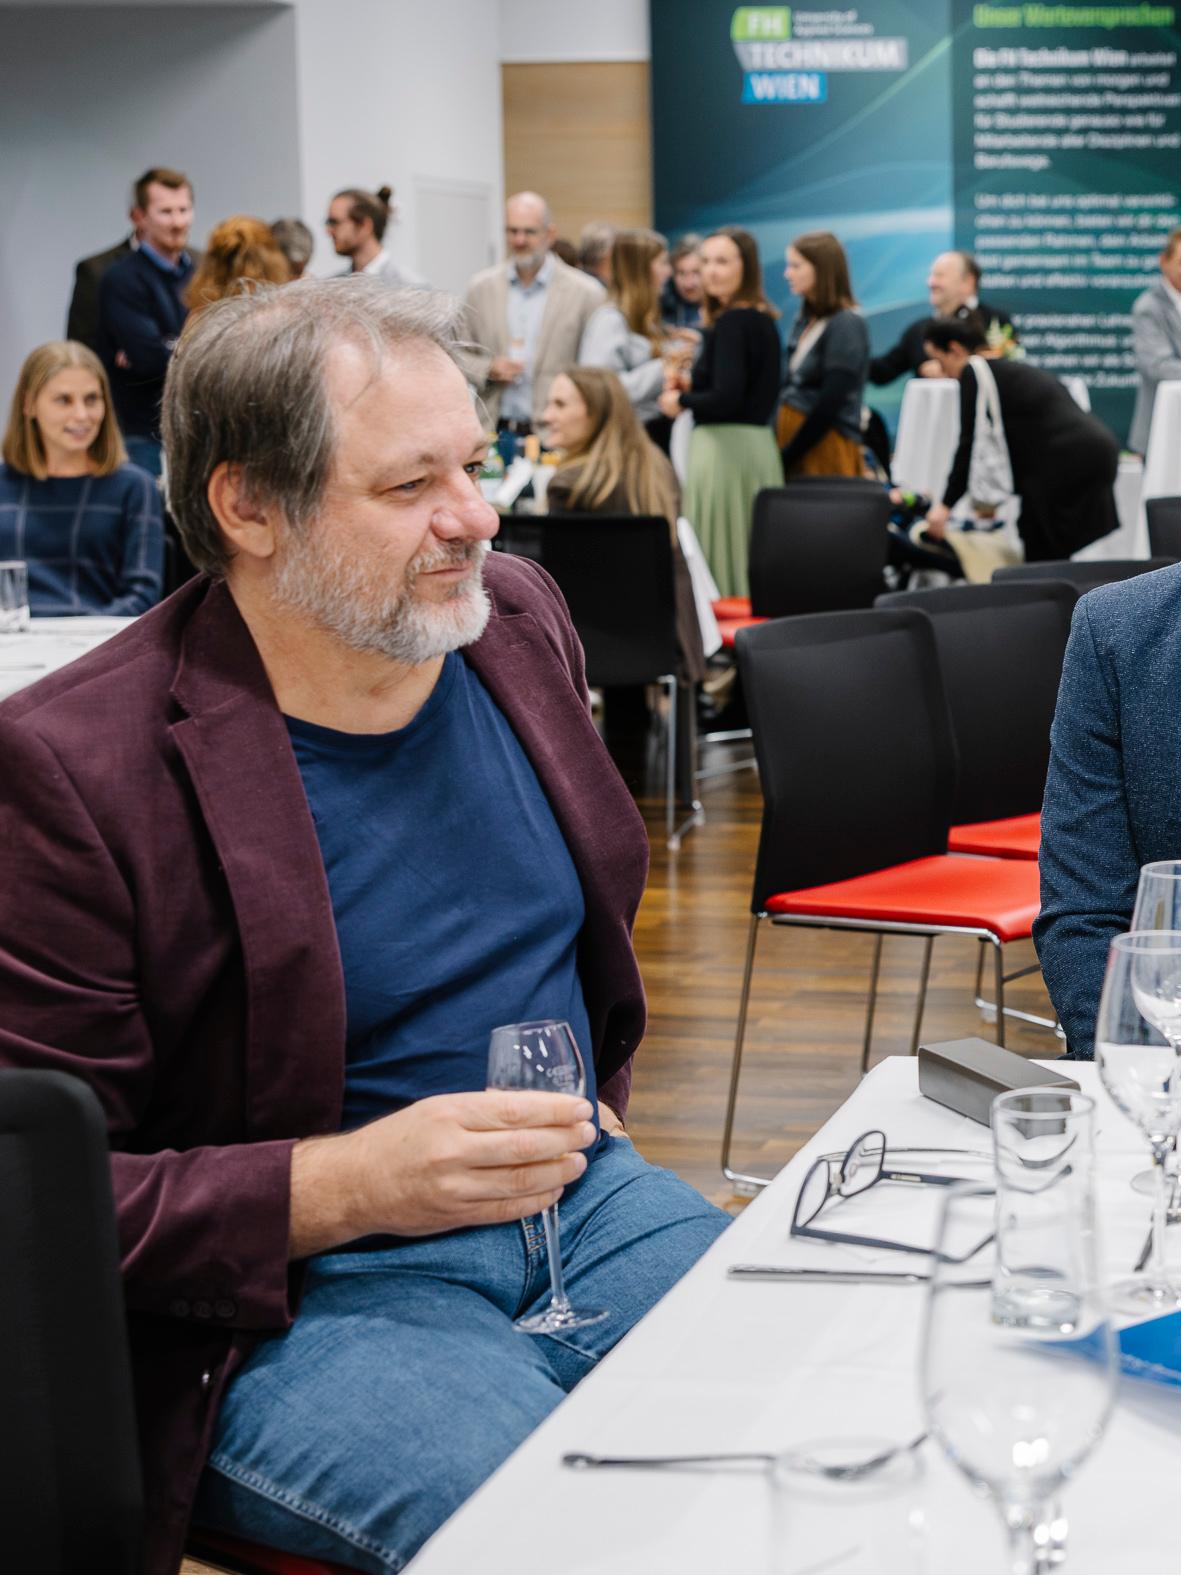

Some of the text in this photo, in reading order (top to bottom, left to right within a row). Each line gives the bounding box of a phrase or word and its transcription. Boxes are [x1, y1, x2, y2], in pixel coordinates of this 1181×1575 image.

[747, 11, 783, 34] FH
[751, 41, 899, 69] TECHNIKUM
[750, 73, 820, 100] WIEN
